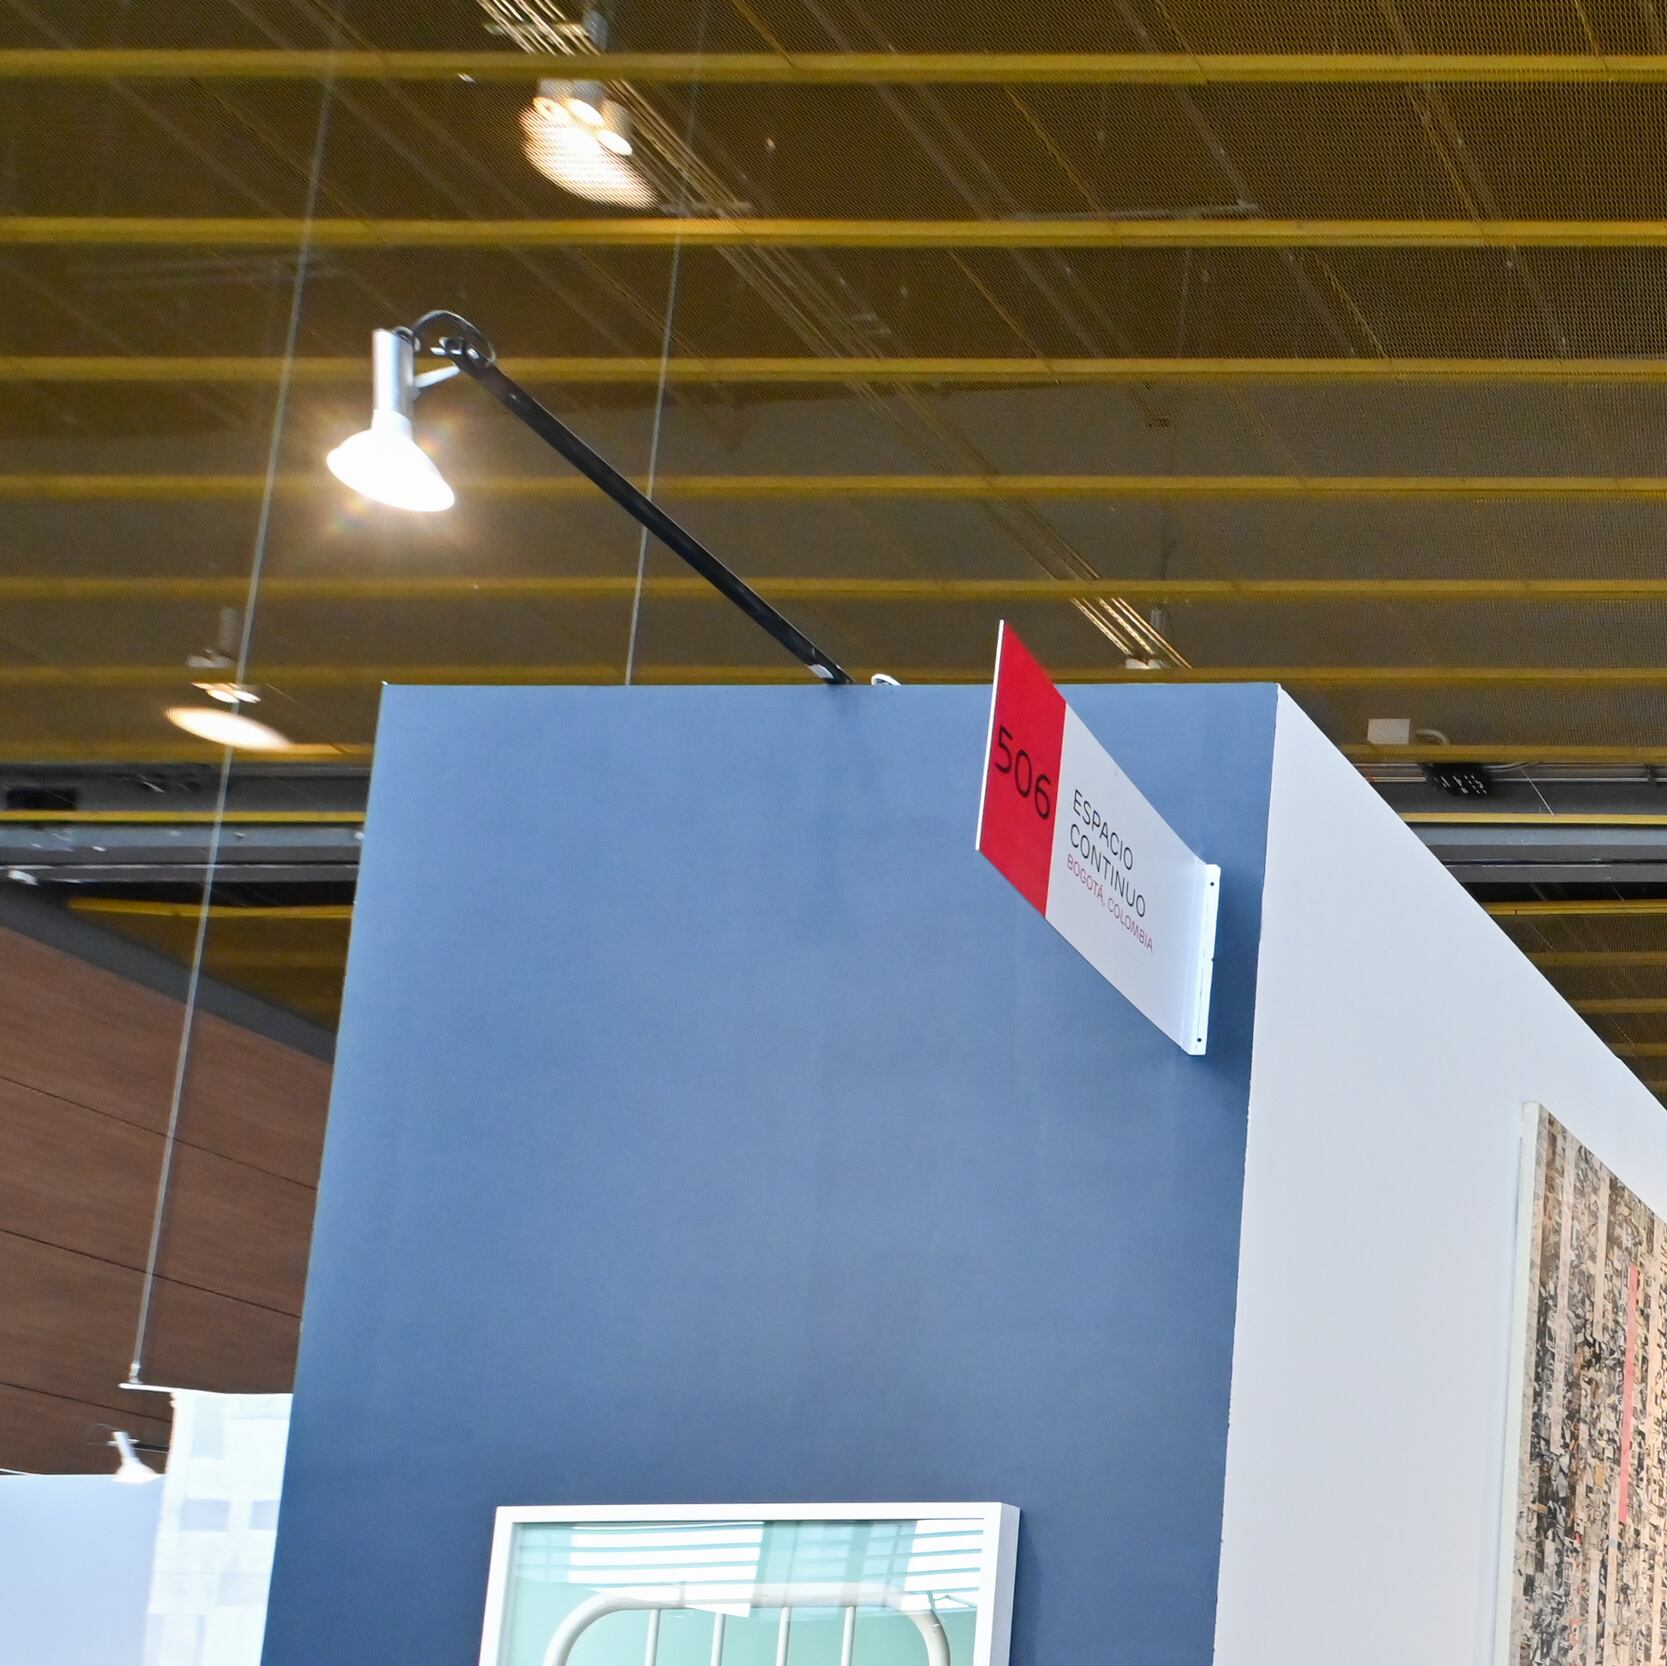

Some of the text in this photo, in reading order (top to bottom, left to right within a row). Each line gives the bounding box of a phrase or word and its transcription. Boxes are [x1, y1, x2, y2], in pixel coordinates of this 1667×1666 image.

[995, 727, 1051, 820] 506
[1070, 824, 1146, 919] CONTINUO
[1073, 789, 1134, 871] ESPACIO
[1066, 853, 1154, 952] BOGOTÁ, COLOMBIA
